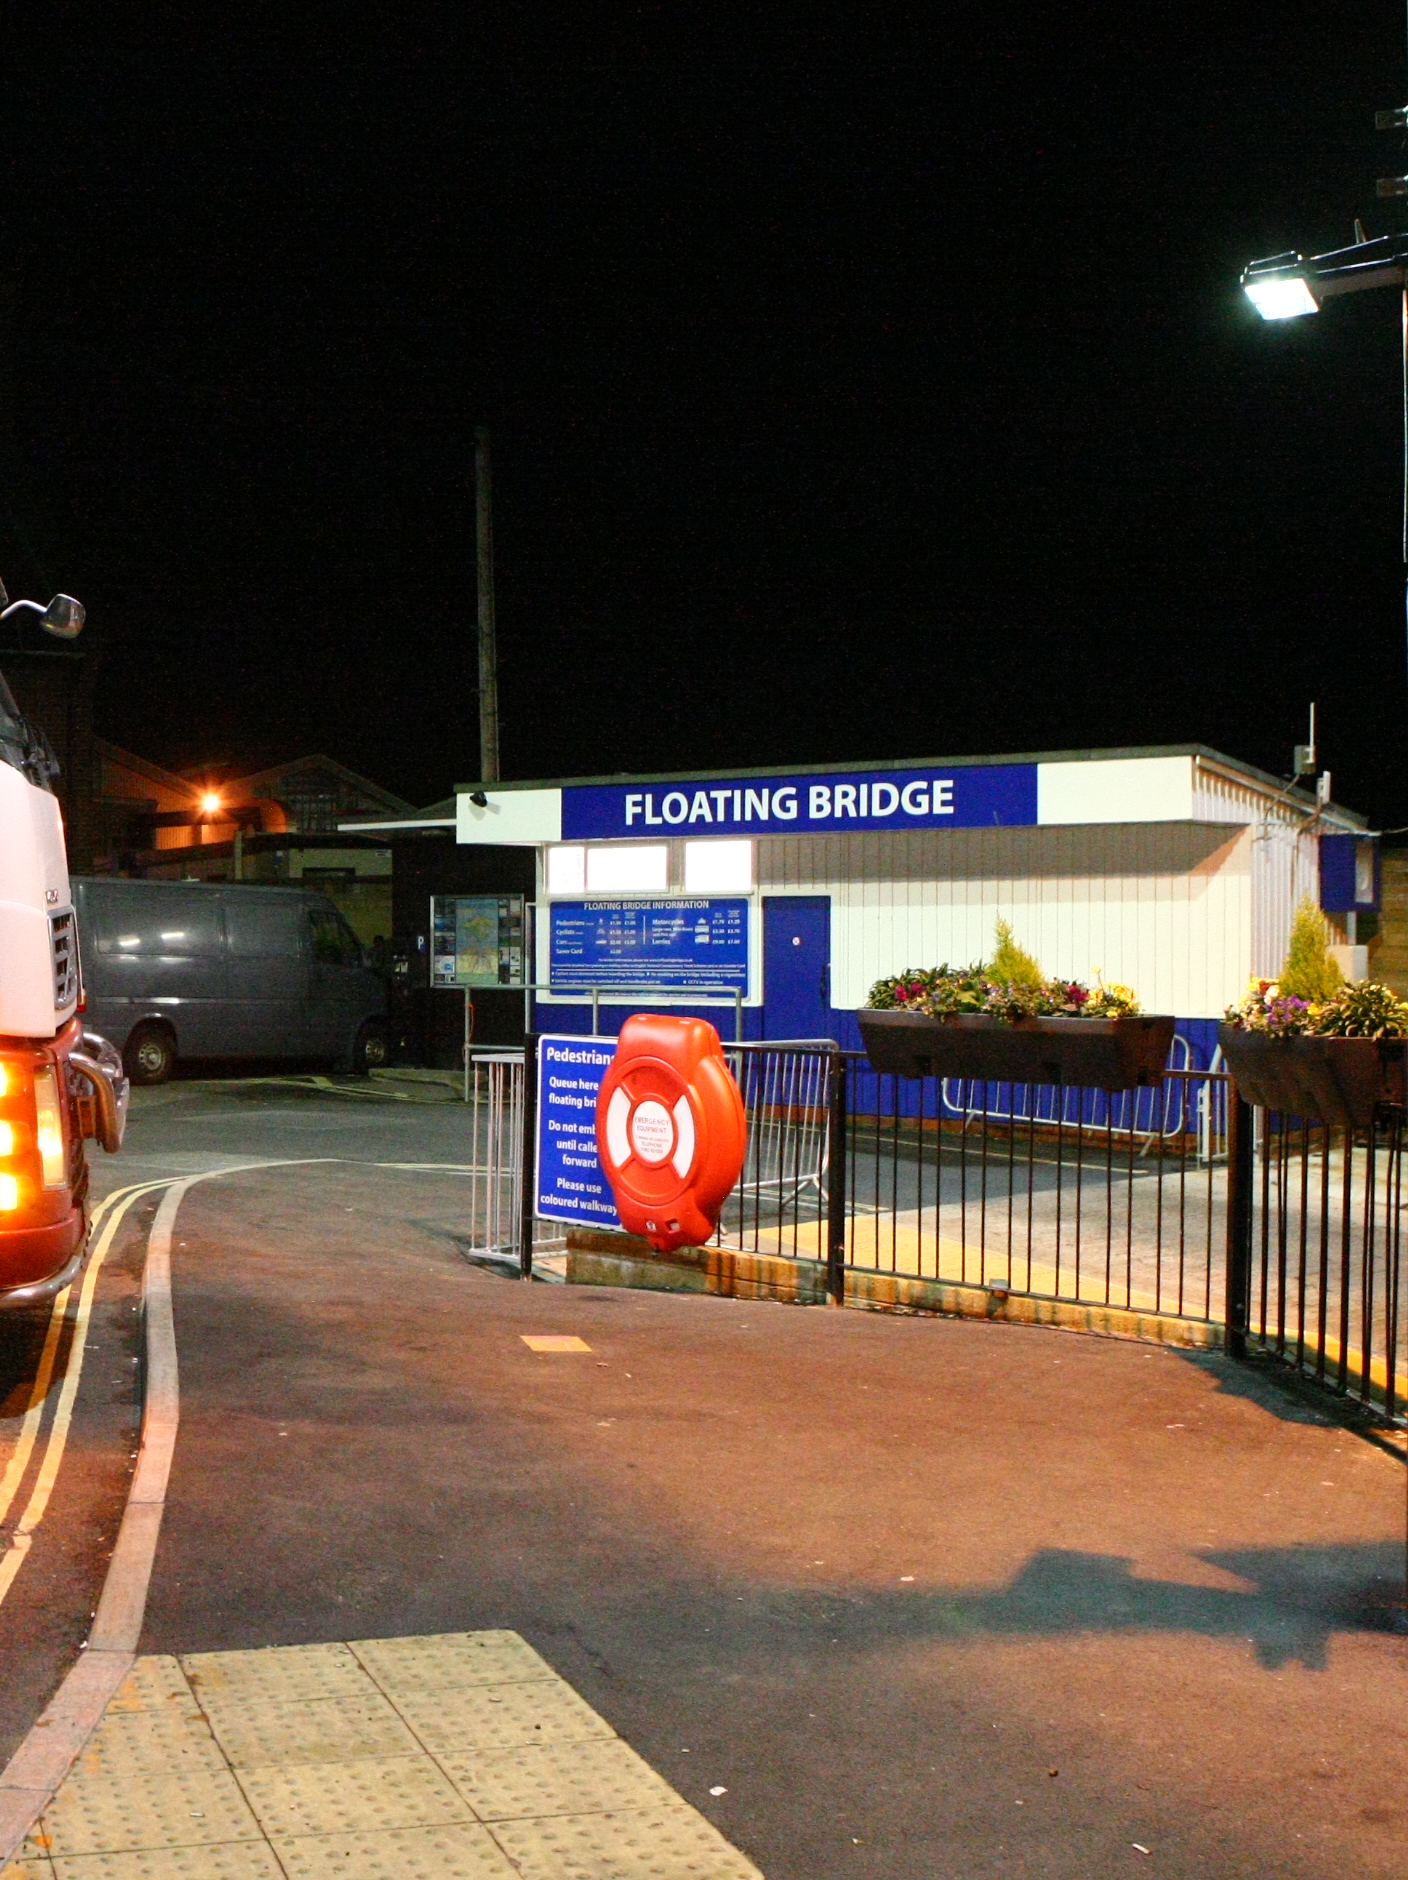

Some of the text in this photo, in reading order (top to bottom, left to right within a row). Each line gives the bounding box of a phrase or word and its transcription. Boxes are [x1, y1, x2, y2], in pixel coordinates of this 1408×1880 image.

[625, 779, 955, 826] FLOATING BRIDGE
[584, 900, 710, 911] FLOATING BRIDGE INFORMATION
[555, 919, 585, 927] Pedestrians
[652, 918, 684, 926] Motorcycles
[549, 1076, 599, 1091] Queue here
[549, 1092, 582, 1109] floating
[548, 1119, 561, 1131] Do
[562, 1123, 577, 1133] not
[634, 1115, 670, 1126] EMERGENCY
[636, 1124, 667, 1135] EQUIPMENT
[556, 1139, 598, 1153] until calle
[562, 1153, 597, 1168] forward
[557, 1177, 602, 1194] Please use
[540, 1194, 618, 1216] coloured walkway
